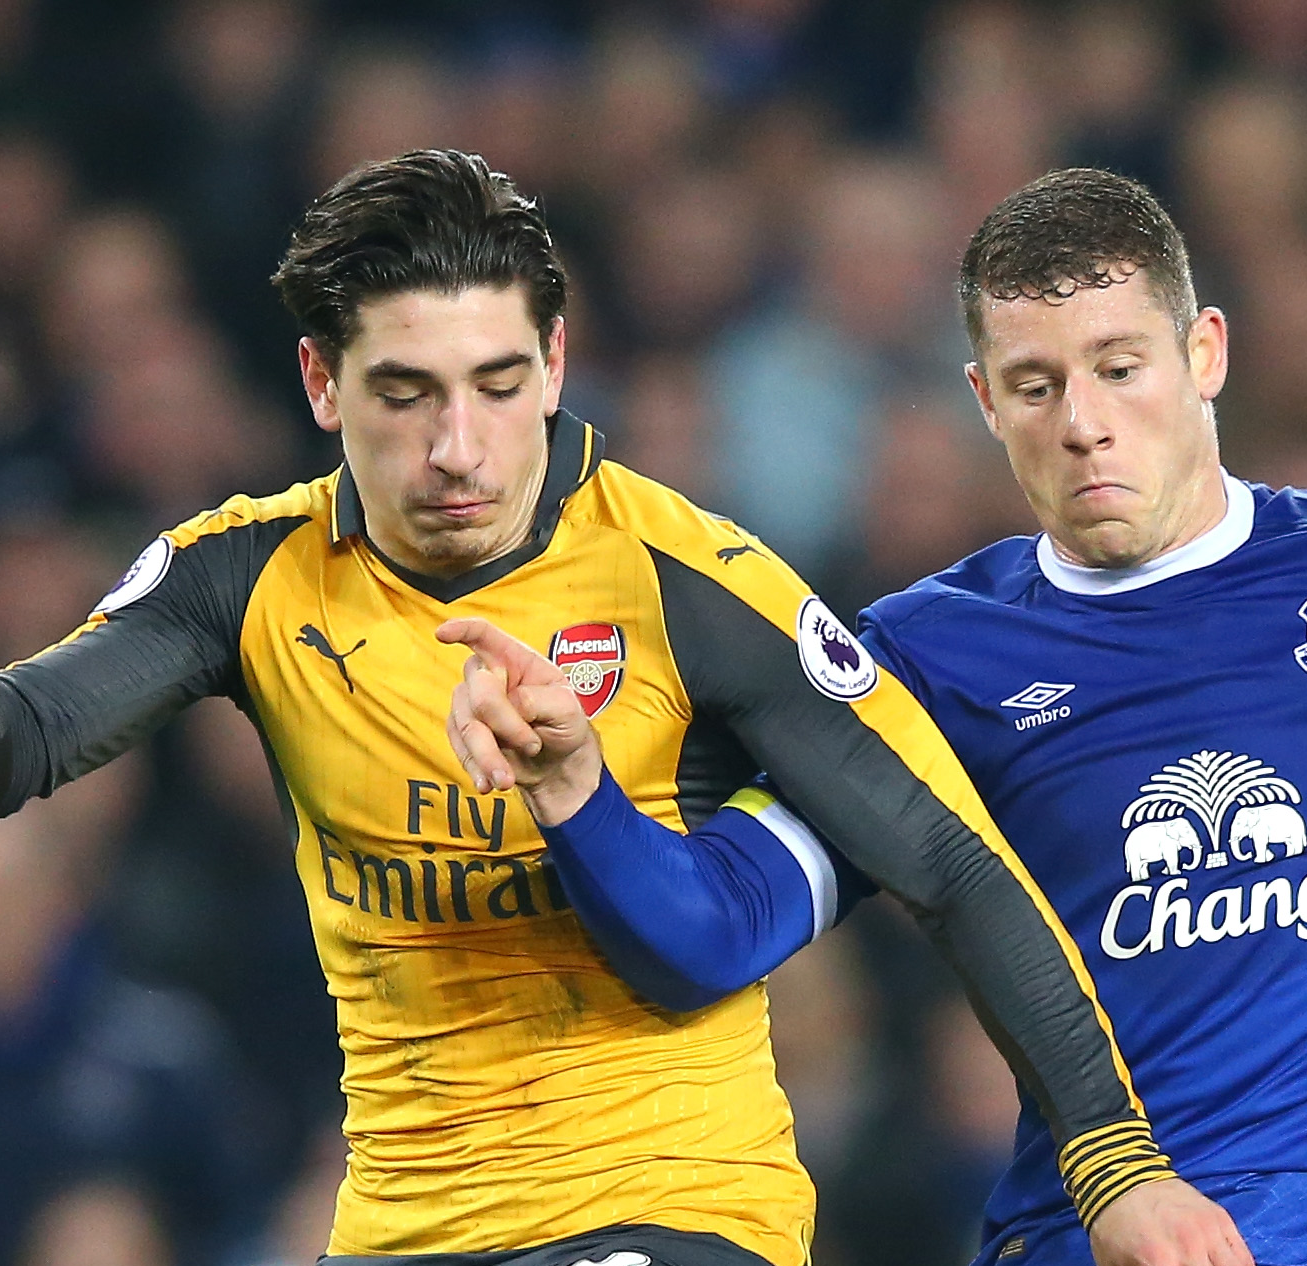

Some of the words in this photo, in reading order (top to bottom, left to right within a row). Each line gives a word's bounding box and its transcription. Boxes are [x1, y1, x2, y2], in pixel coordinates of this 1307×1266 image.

[556, 635, 617, 655] Arsenal
[1014, 705, 1071, 731] umbro
[406, 779, 506, 852] Fly
[311, 820, 573, 919] Emirat
